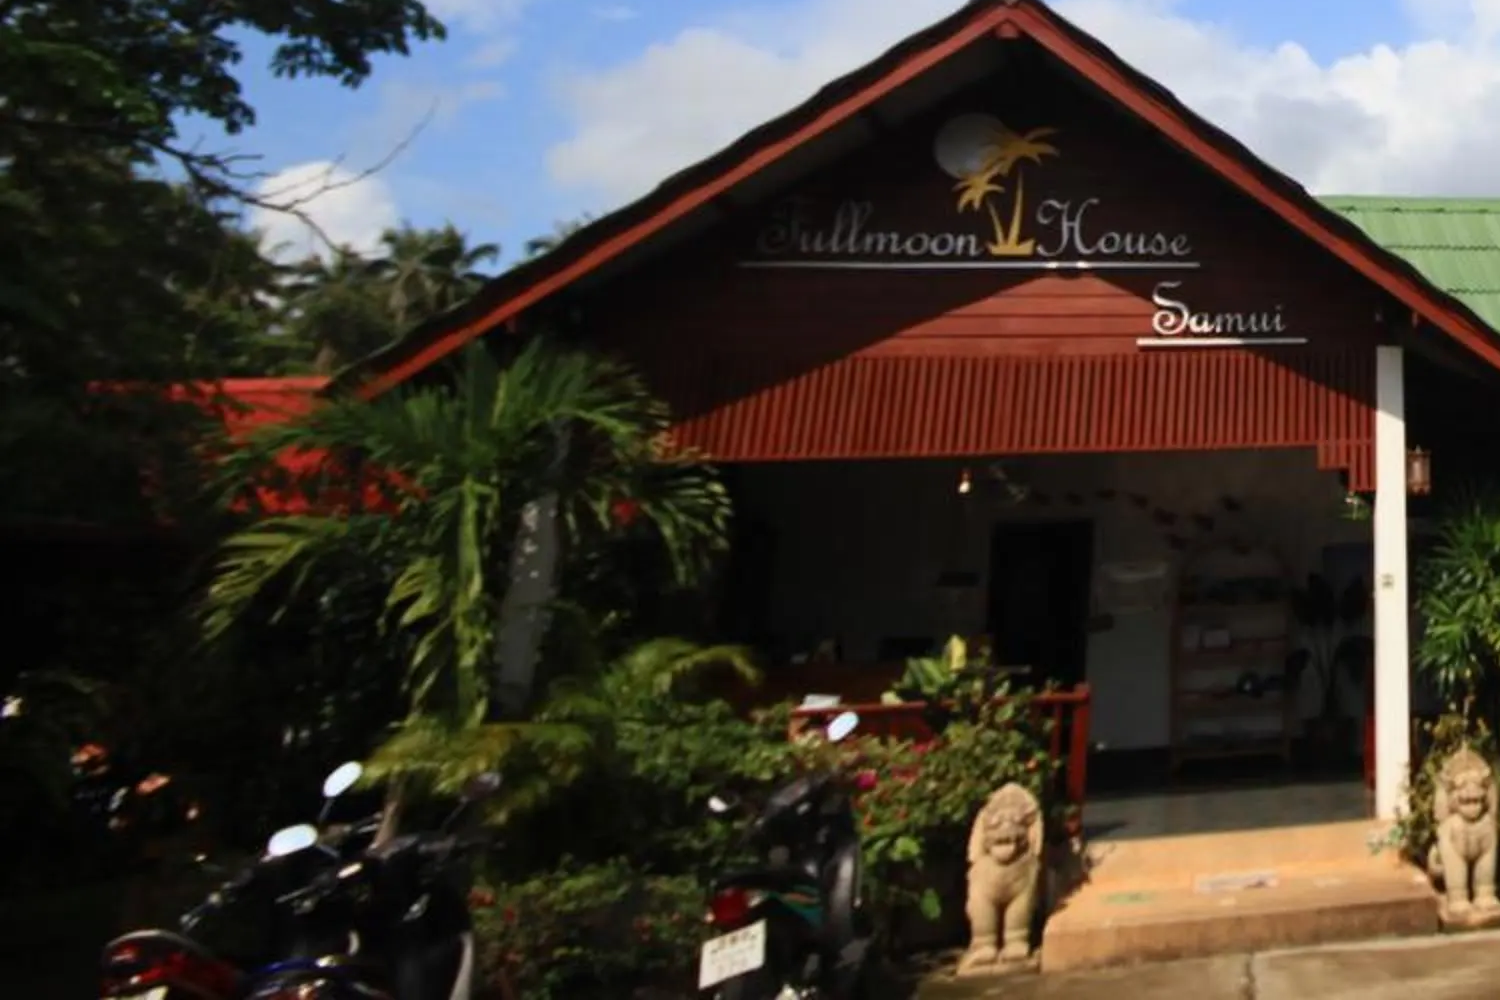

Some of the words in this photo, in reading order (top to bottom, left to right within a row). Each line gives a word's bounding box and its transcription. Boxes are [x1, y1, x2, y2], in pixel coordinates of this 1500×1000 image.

[757, 194, 983, 257] Fullmoon
[1036, 199, 1192, 257] House
[1151, 281, 1286, 335] Samui
